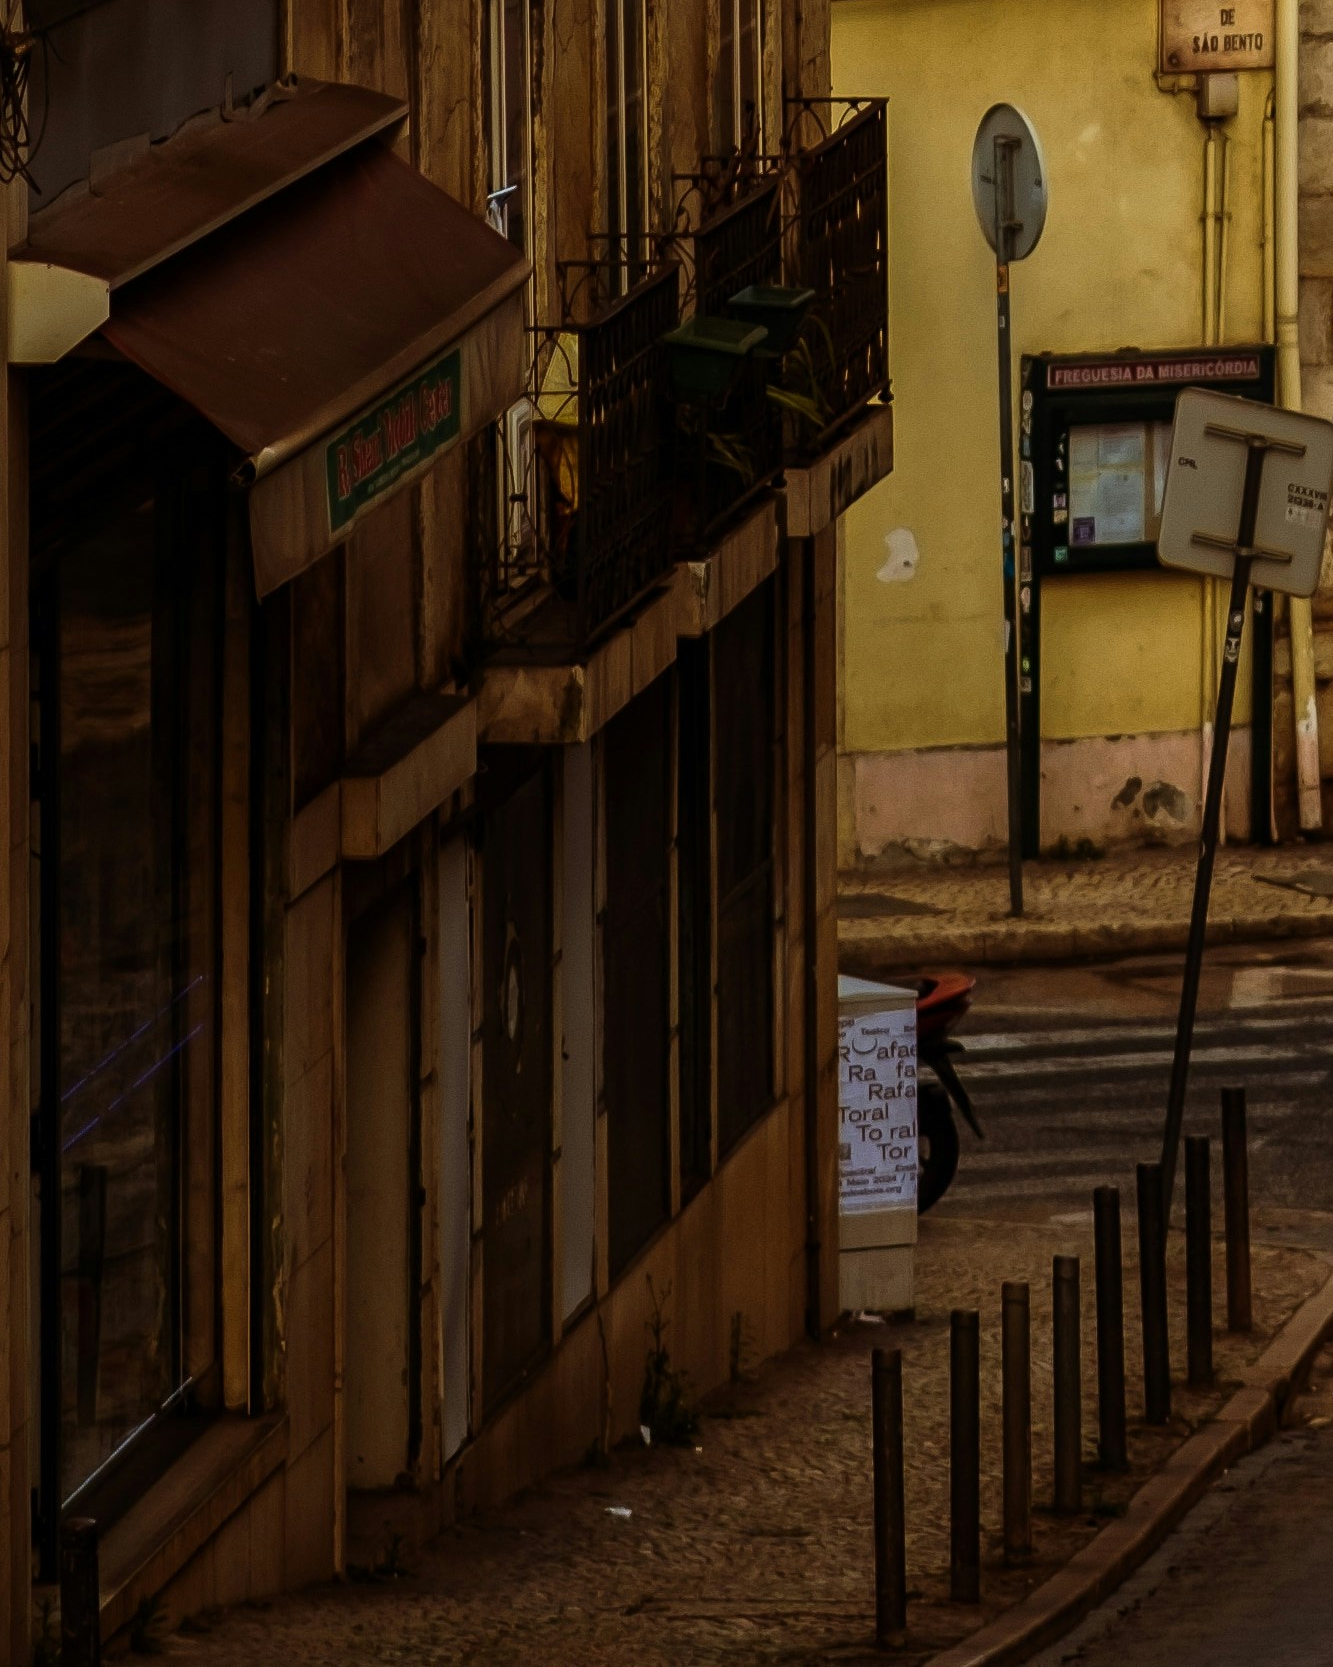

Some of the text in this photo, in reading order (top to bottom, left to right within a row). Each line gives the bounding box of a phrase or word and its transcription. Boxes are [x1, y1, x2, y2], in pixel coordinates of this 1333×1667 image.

[1219, 8, 1236, 26] DE
[1223, 32, 1264, 52] BENTO
[1054, 367, 1132, 385] FREGUESIA
[1136, 365, 1155, 380] DA
[848, 1064, 877, 1082] Ra
[840, 1102, 889, 1123] Toral
[876, 1142, 912, 1161] Tor
